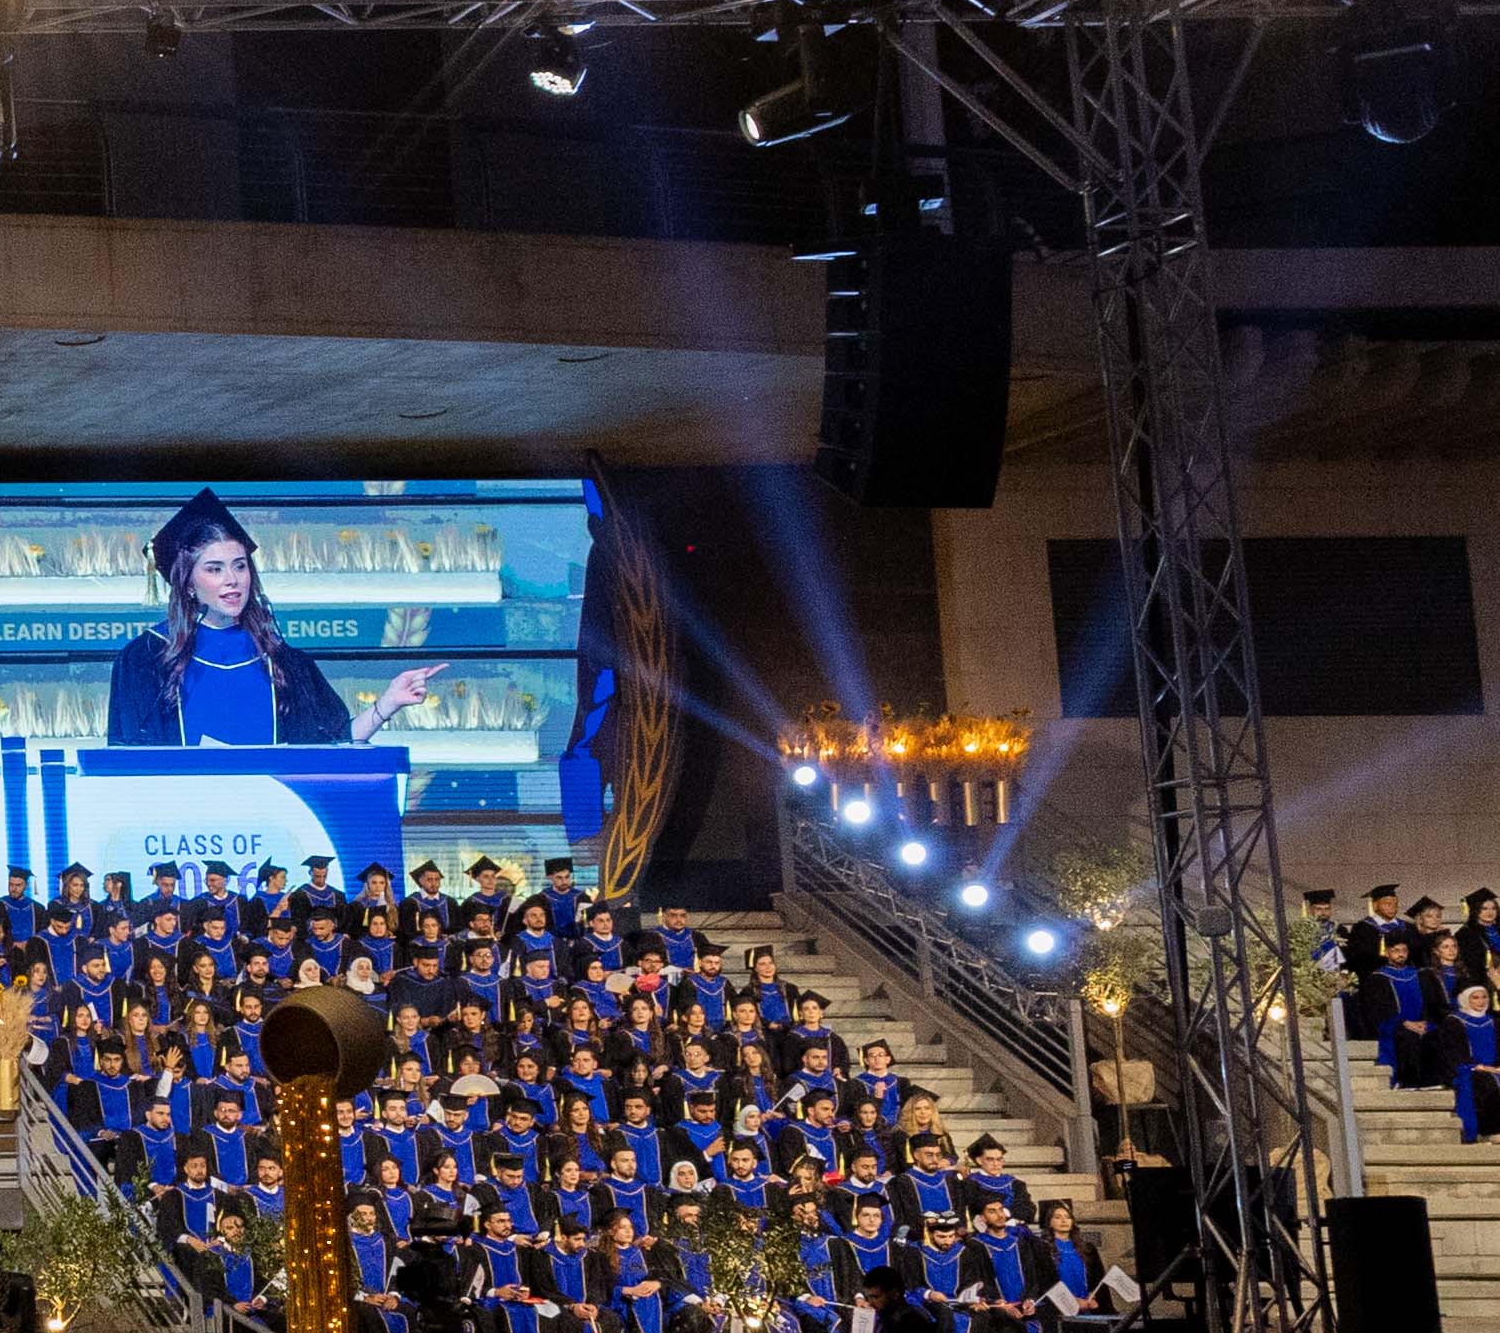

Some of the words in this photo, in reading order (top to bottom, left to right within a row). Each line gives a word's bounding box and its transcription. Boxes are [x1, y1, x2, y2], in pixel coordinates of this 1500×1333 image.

[69, 621, 155, 641] DESPIT
[281, 619, 359, 639] ENGES
[144, 834, 223, 856] CLASS
[233, 834, 262, 855] OF
